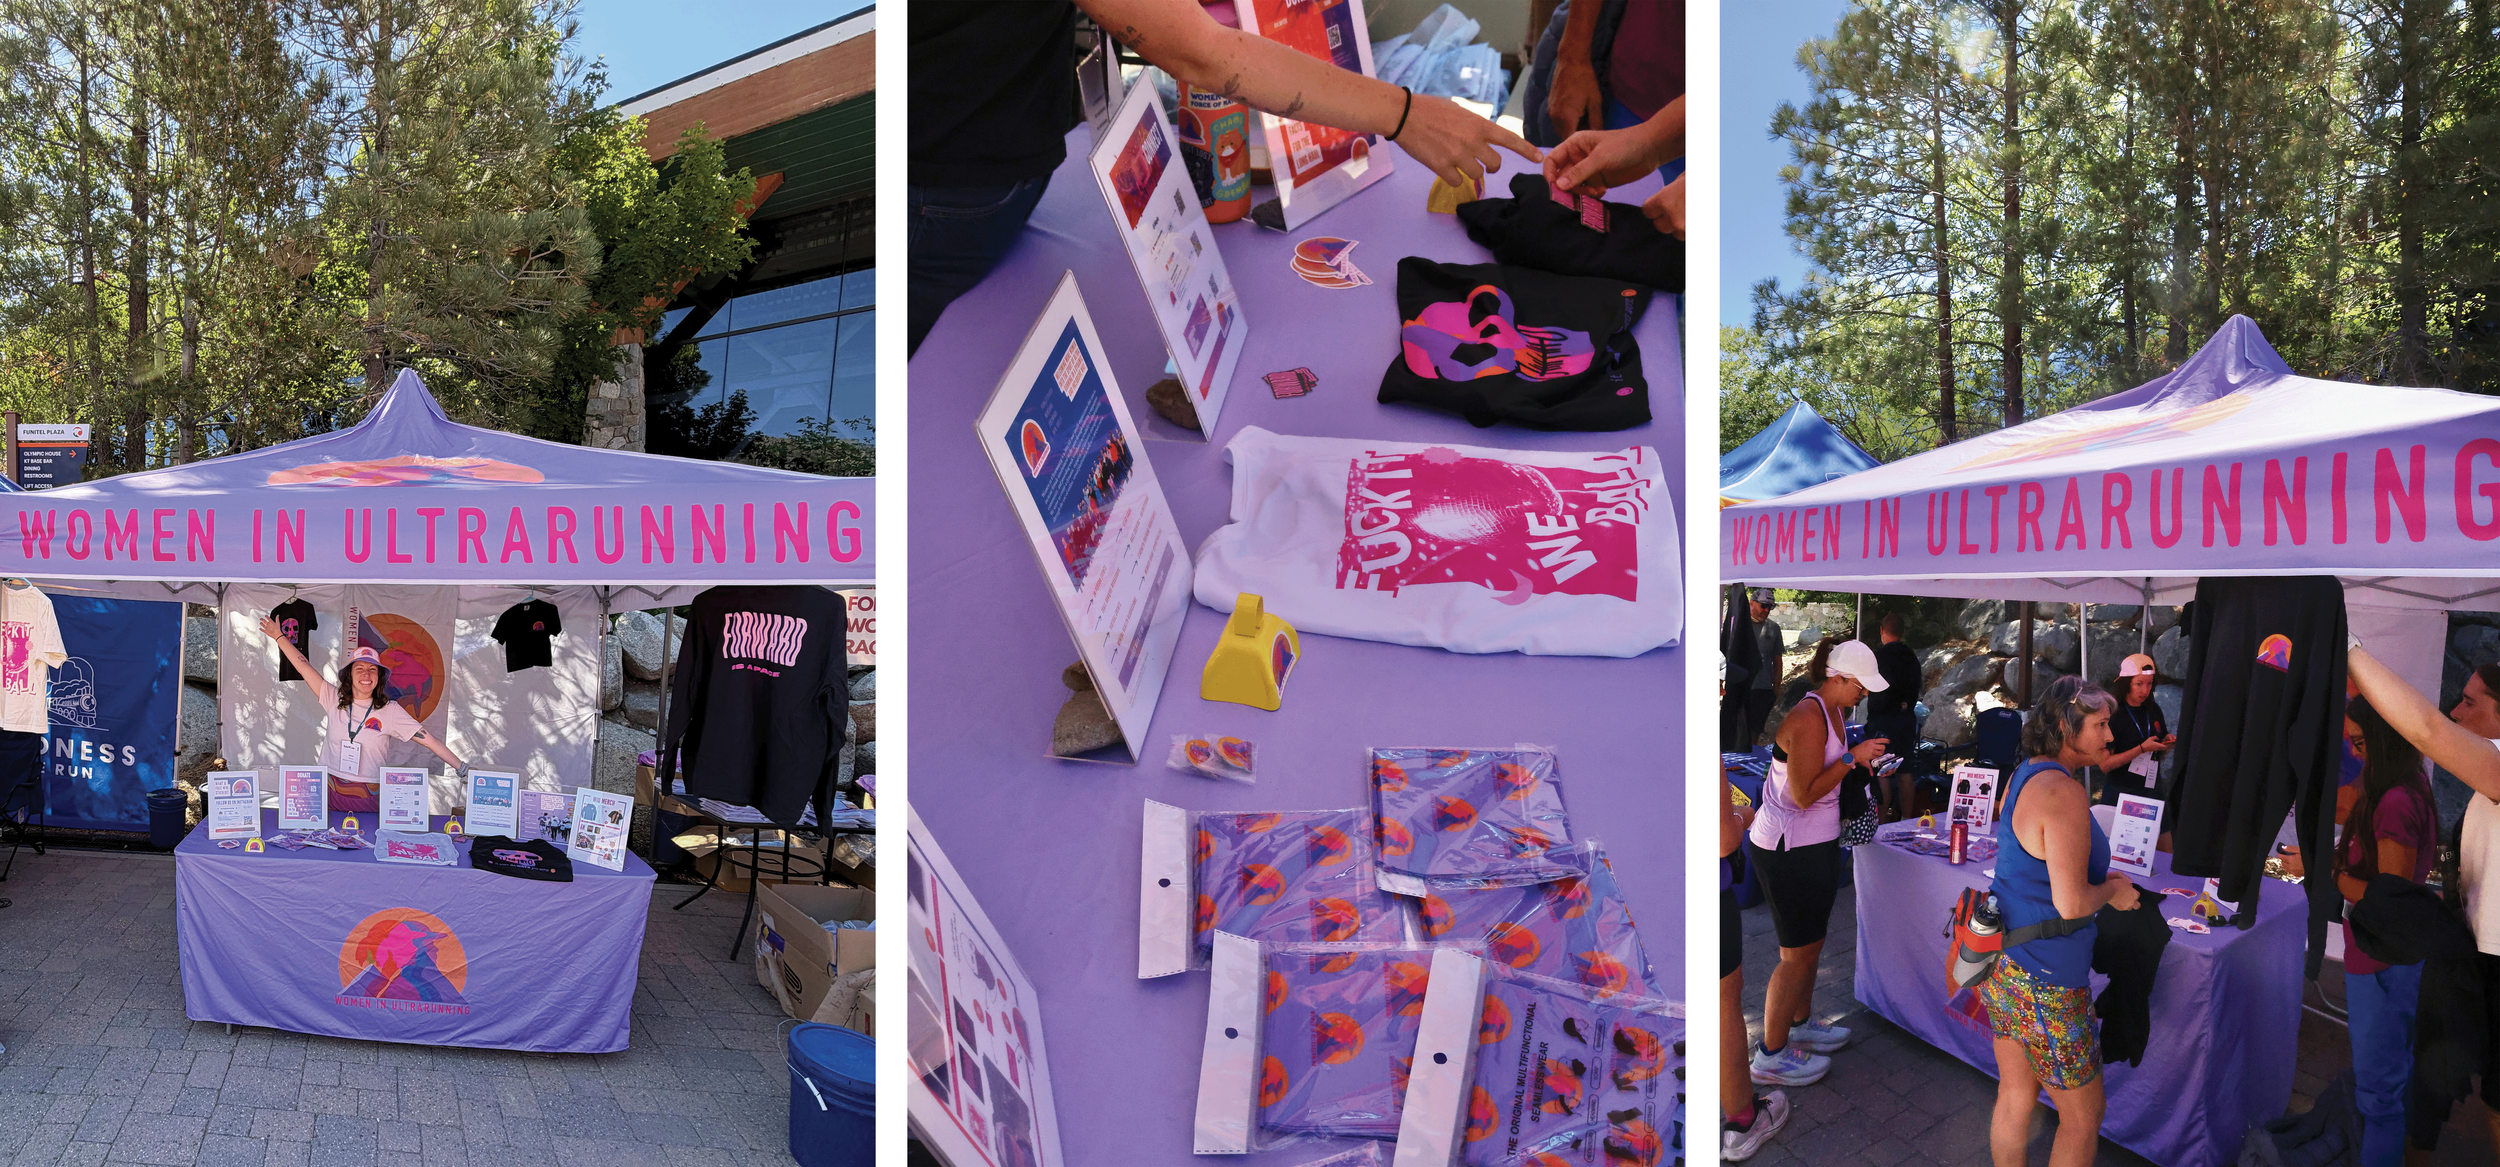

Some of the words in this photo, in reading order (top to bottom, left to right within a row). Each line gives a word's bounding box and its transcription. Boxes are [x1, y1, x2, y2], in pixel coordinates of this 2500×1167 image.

[1190, 92, 1221, 100] WOMEN
[1142, 122, 1162, 165] CONNECT
[1301, 136, 1310, 147] THE
[1297, 156, 1308, 169] LONG
[1364, 450, 1414, 480] IT
[1584, 445, 1652, 527] BALL
[1732, 504, 1842, 566] WOMEN
[1862, 497, 1900, 559] IN
[1927, 437, 2500, 557] ULTRARUNNING
[18, 508, 215, 562] WOMEN
[252, 508, 305, 563] IN
[344, 500, 863, 564] ULTRARUNNING
[1343, 483, 1412, 598] FUCK
[1526, 511, 1598, 586] WE
[848, 596, 876, 611] FO
[348, 606, 358, 643] WOMEN
[723, 611, 808, 667] FORWARD
[754, 666, 780, 677] PACE
[6, 678, 36, 696] BALL
[55, 764, 92, 779] RUN
[602, 798, 615, 806] MERCH
[2142, 808, 2156, 816] CONNECT
[334, 996, 371, 1008] WOMEN
[376, 1000, 386, 1009] IN
[392, 1001, 470, 1015] ULTRARUNNING
[1944, 1006, 1968, 1028] WOMEN
[1970, 1020, 1978, 1033] IN
[1517, 1002, 1536, 1086] MULTIFUNCTIONAL
[1537, 1042, 1548, 1070] WEAR
[1531, 1072, 1544, 1123] SEAMLESS
[1510, 1089, 1525, 1135] ORIGINAL
[1507, 1137, 1518, 1156] THE
